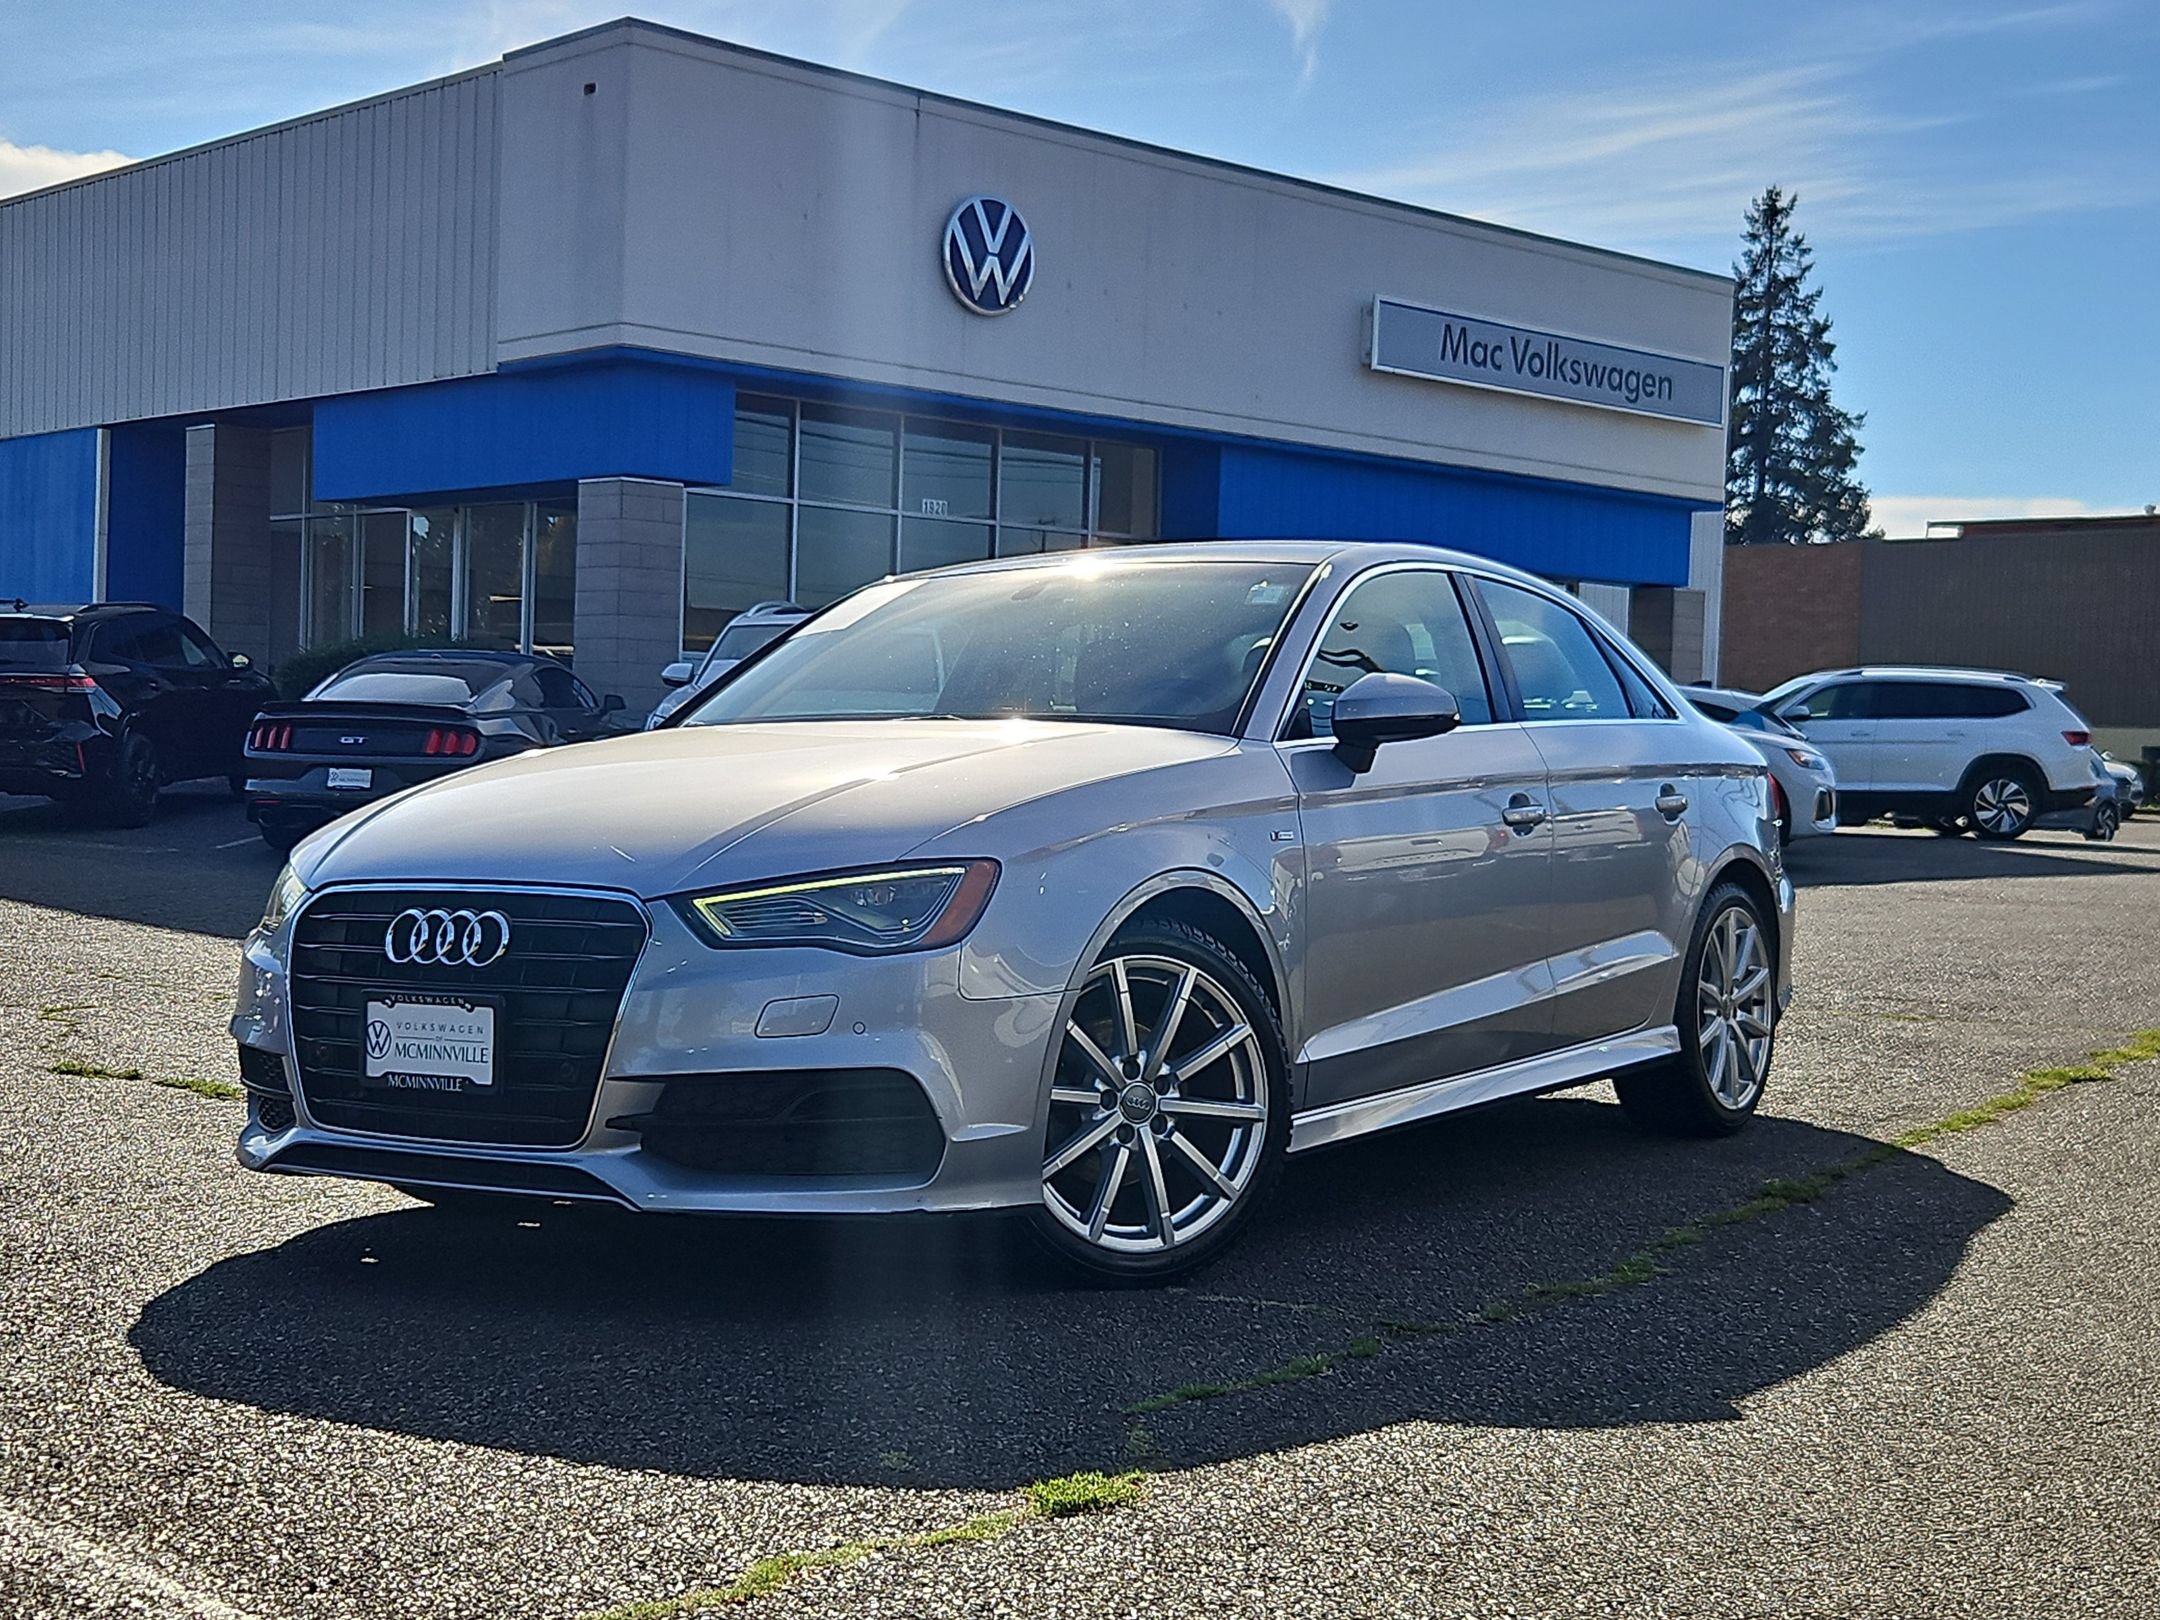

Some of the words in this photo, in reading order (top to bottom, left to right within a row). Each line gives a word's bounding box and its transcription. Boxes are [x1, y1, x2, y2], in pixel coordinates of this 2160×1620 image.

[945, 197, 1034, 315] VW
[1440, 323, 1503, 371] Mac
[1509, 336, 1673, 403] Volkswagen
[339, 735, 368, 744] GT
[391, 994, 464, 1005] VOLKSWAGEN
[396, 1022, 484, 1034] VOLKSWAGEN
[395, 1042, 489, 1064] MCMINNVILLE
[388, 1074, 463, 1091] MCMINNVILLE
